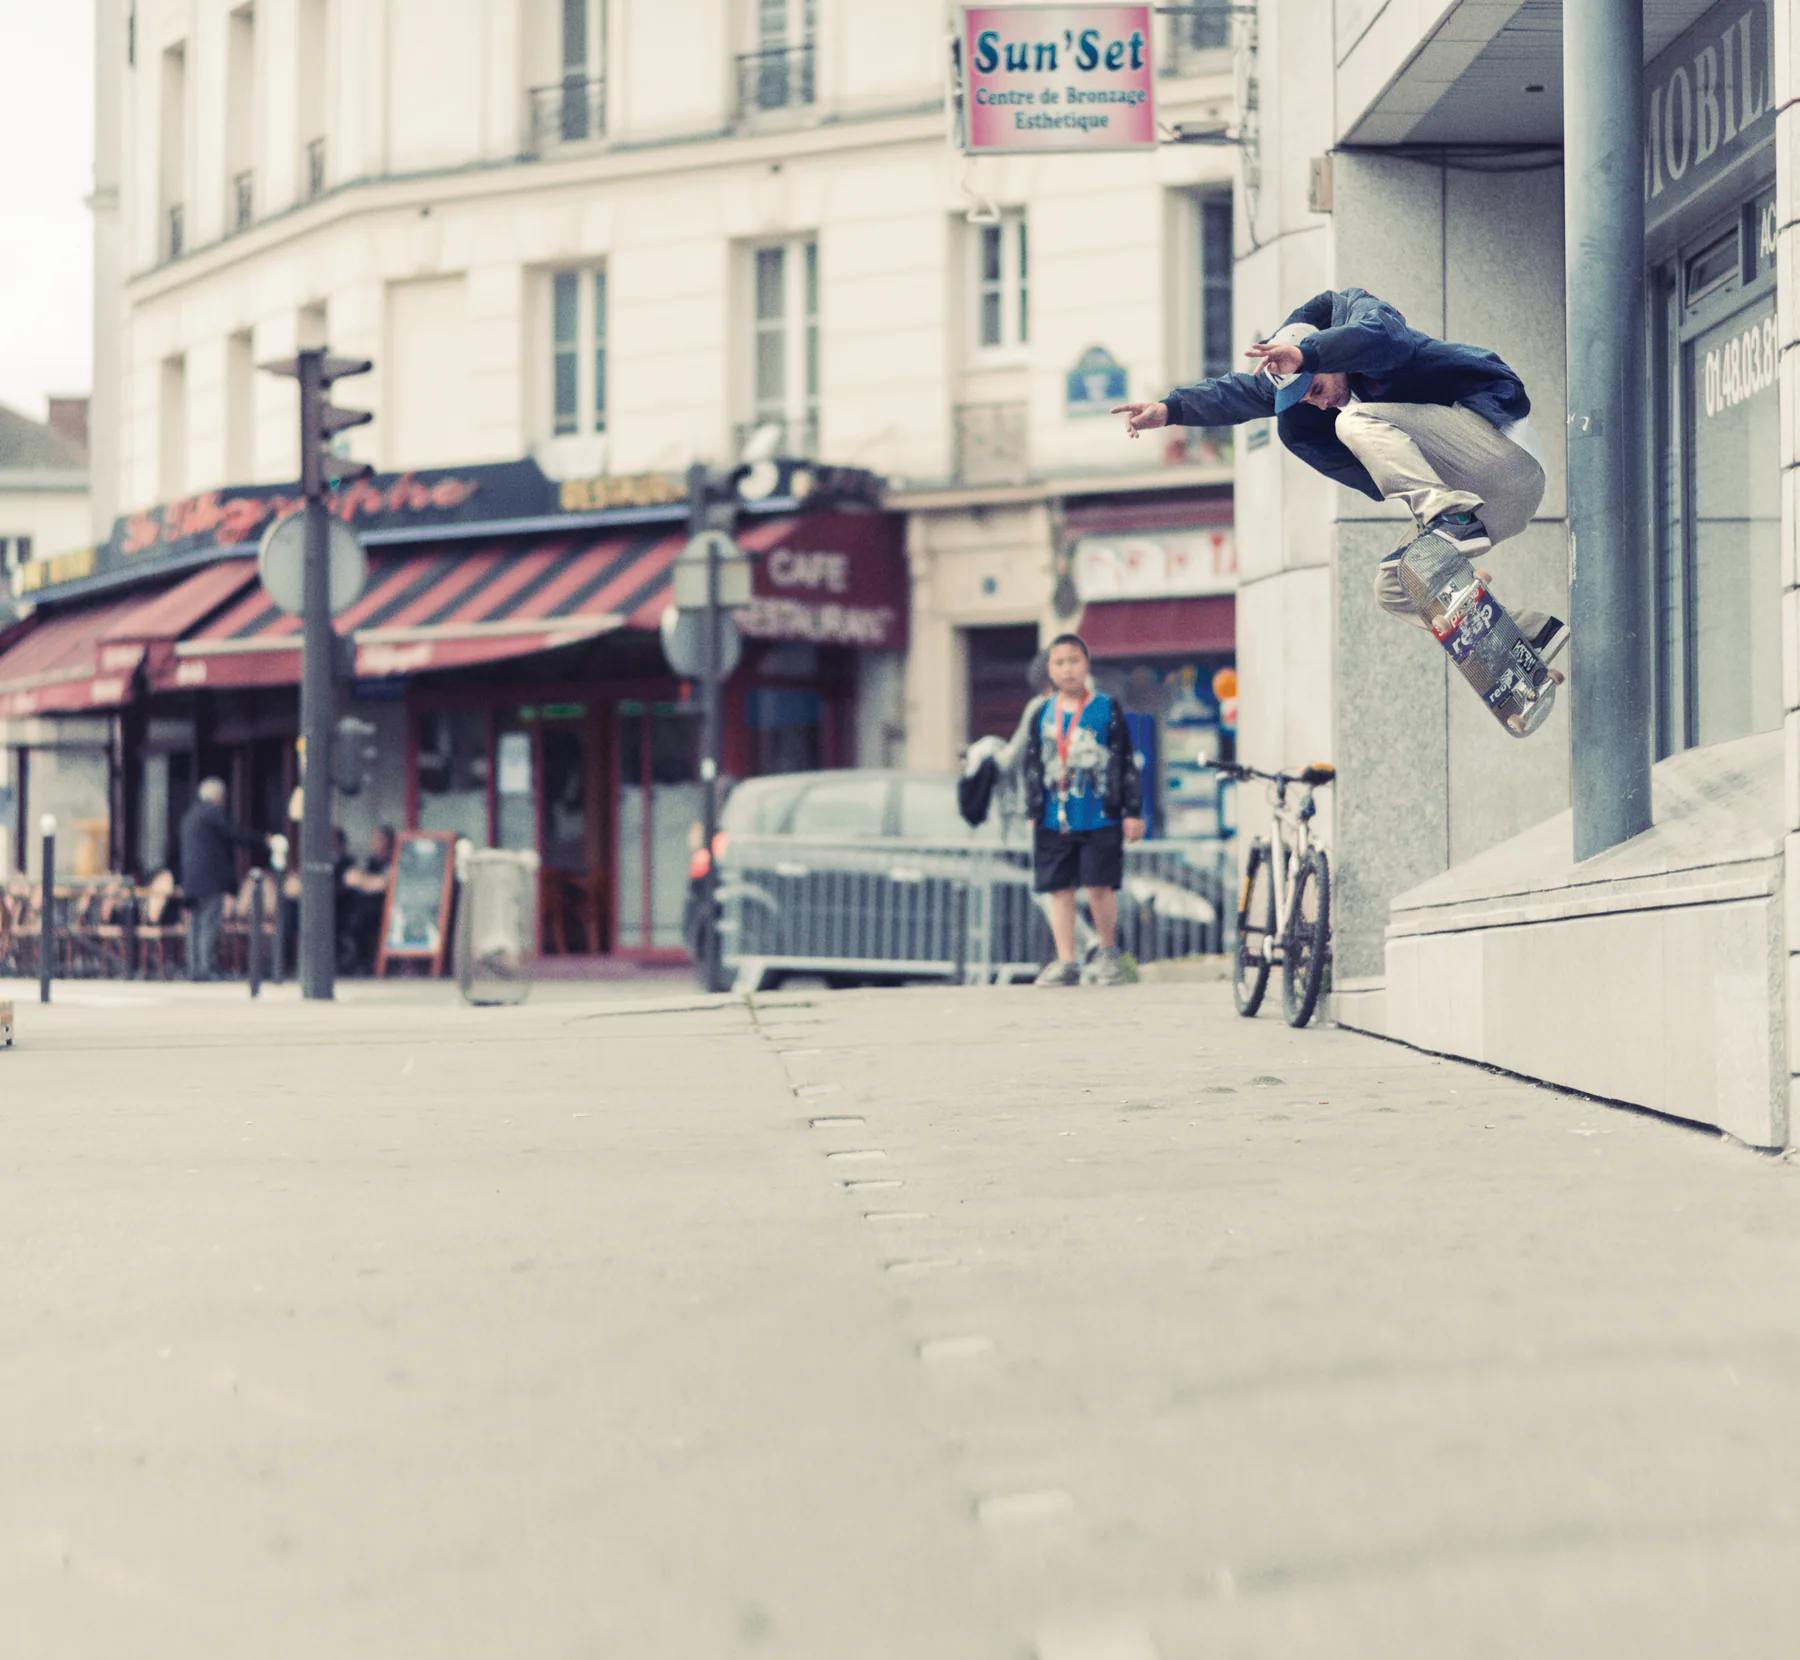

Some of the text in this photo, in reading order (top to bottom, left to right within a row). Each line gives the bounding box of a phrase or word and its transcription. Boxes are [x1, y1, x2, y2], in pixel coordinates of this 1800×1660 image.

[974, 29, 1144, 75] Sun'Set
[975, 86, 1146, 107] Centre de Bronzage
